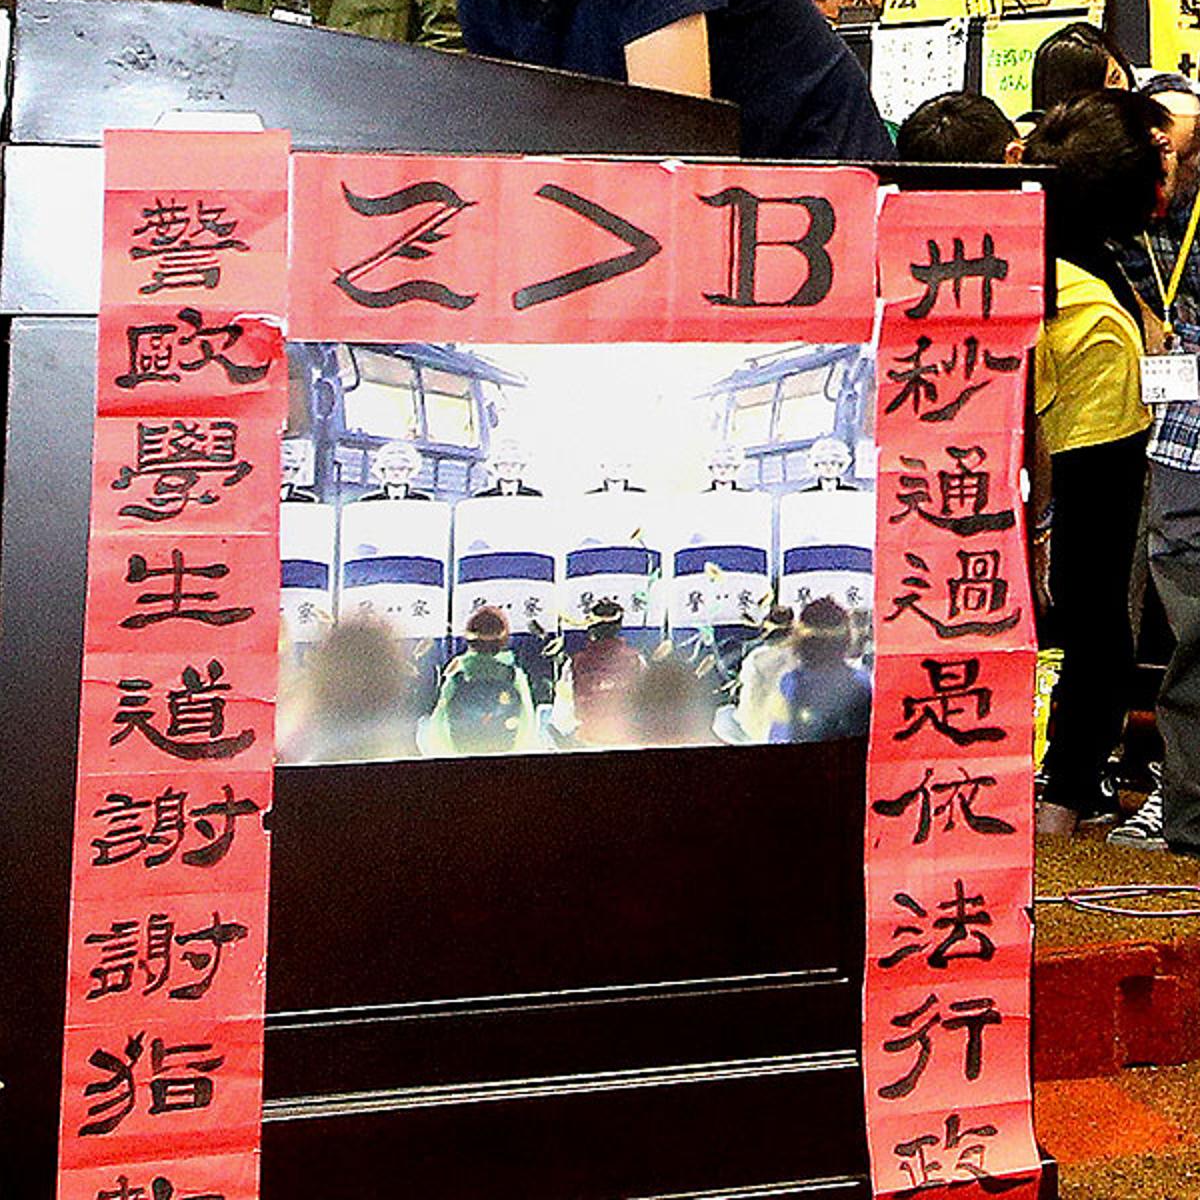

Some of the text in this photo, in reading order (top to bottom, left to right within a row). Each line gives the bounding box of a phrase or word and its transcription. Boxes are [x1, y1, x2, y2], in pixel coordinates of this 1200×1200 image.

[332, 180, 480, 310] Z
[696, 186, 836, 308] B
[78, 197, 270, 1200] 警歐學生道謝謝指
